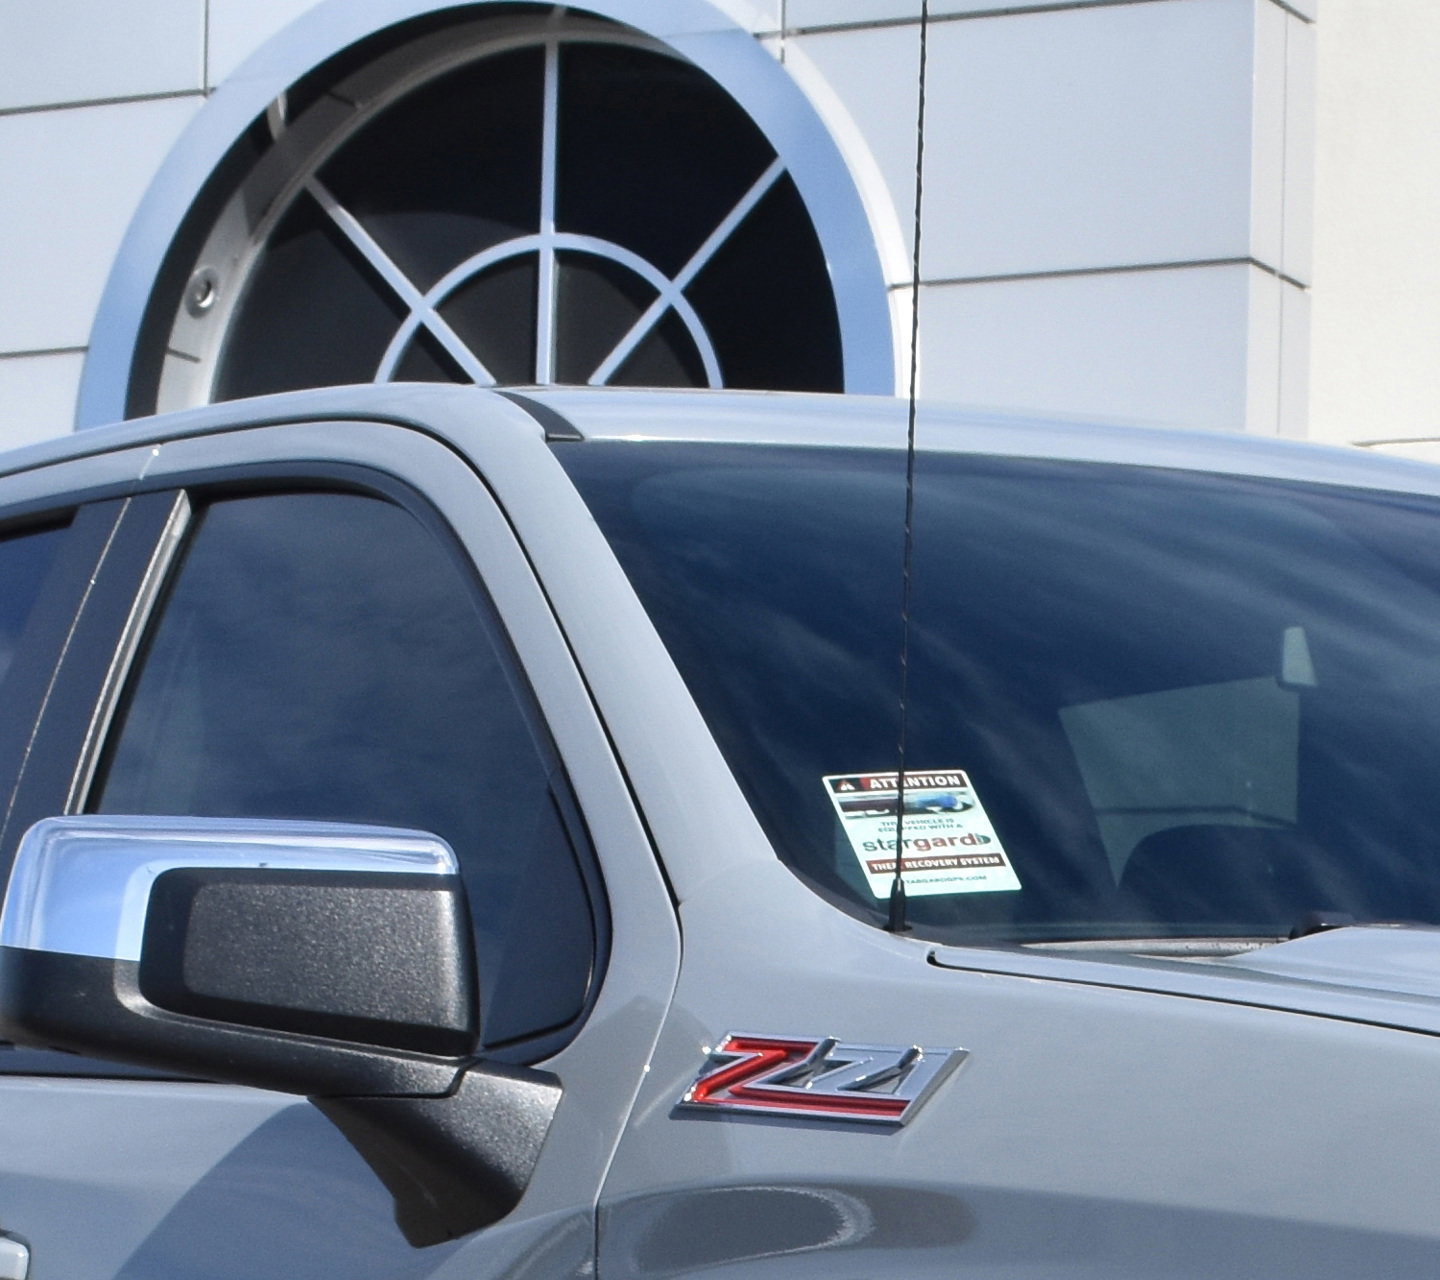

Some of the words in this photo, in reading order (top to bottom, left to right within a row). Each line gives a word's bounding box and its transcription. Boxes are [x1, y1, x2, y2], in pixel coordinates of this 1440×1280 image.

[904, 859, 959, 869] RECOVERY
[960, 857, 1001, 866] SYSTEM
[669, 1030, 969, 1126] Z71
